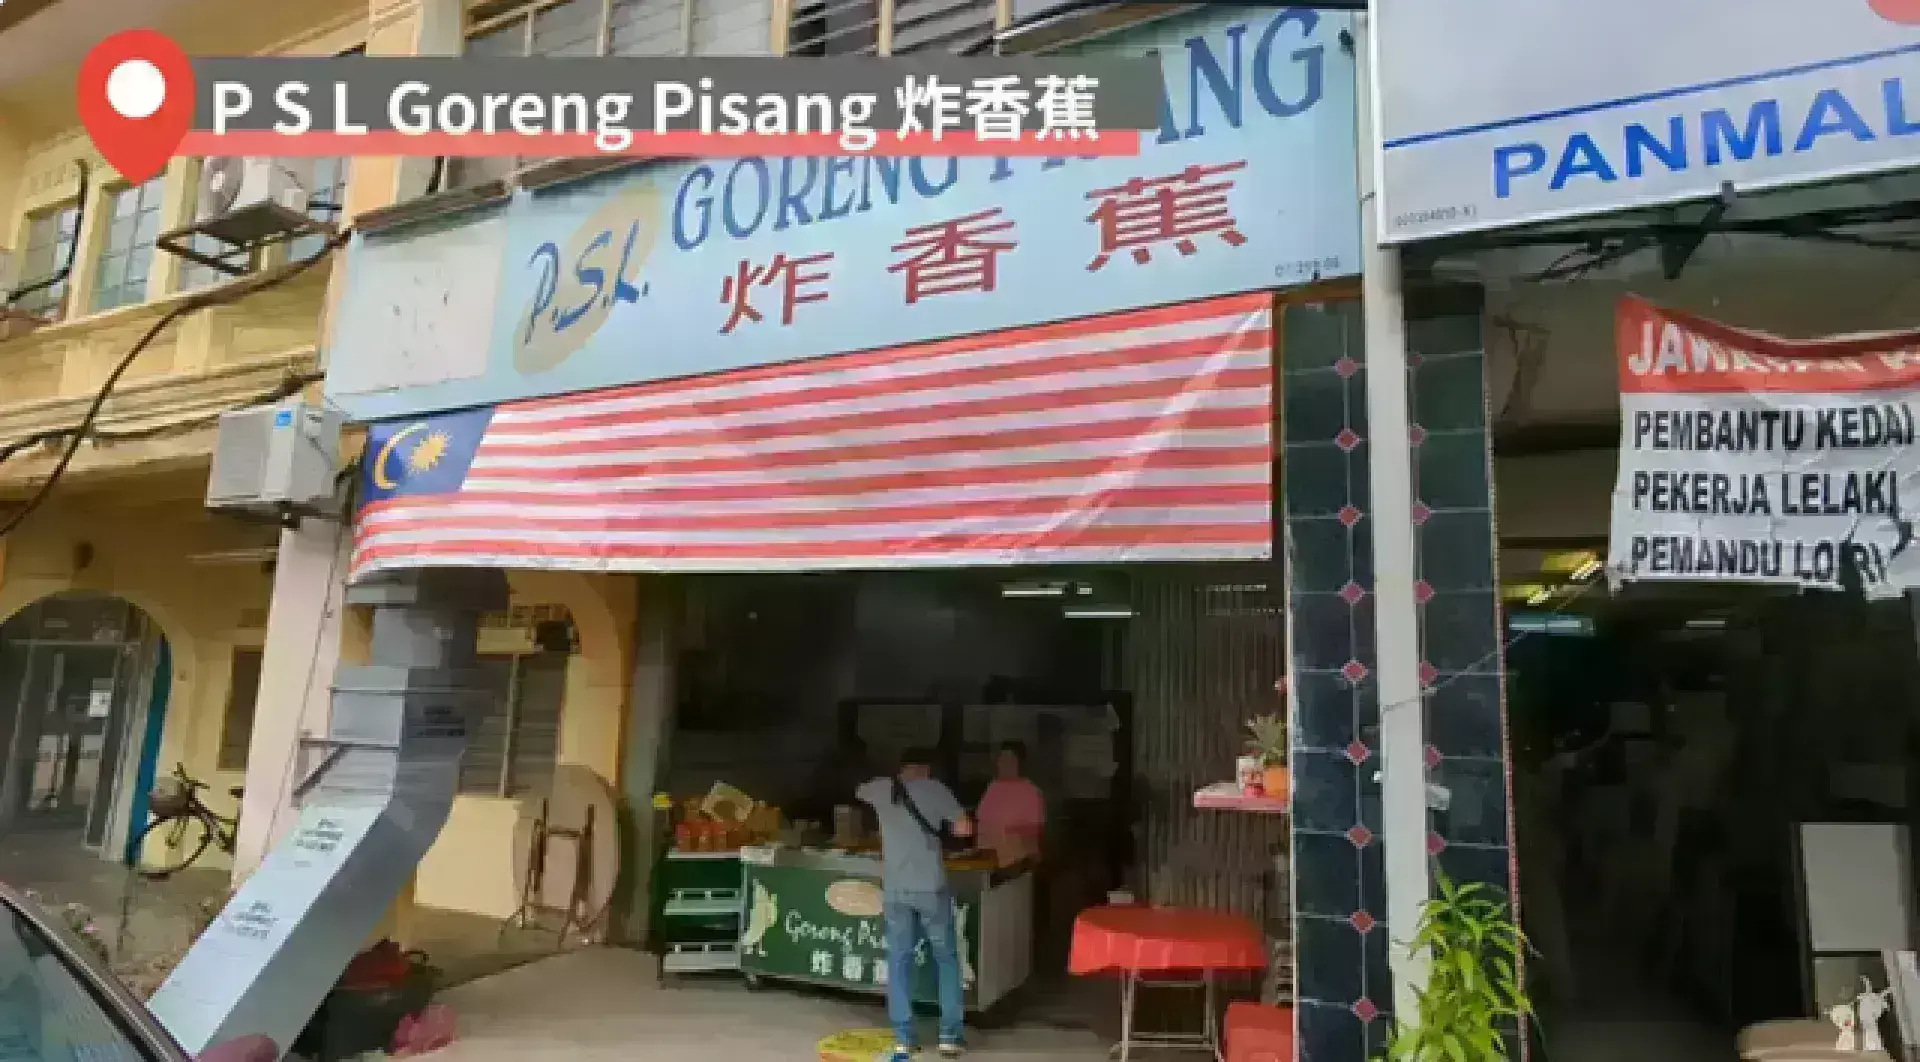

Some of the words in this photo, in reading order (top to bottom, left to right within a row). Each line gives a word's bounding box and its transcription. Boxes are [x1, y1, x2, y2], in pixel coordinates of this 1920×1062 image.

[1493, 76, 1920, 199] PANMAL
[718, 159, 1248, 335] 炸香蕉
[1634, 410, 1804, 450] PEMBANTU
[1817, 402, 1914, 449] KEDAI
[1633, 471, 1771, 513] PEKERJA
[1782, 471, 1899, 516] LELAKI
[1631, 536, 1782, 576] PEMANDU
